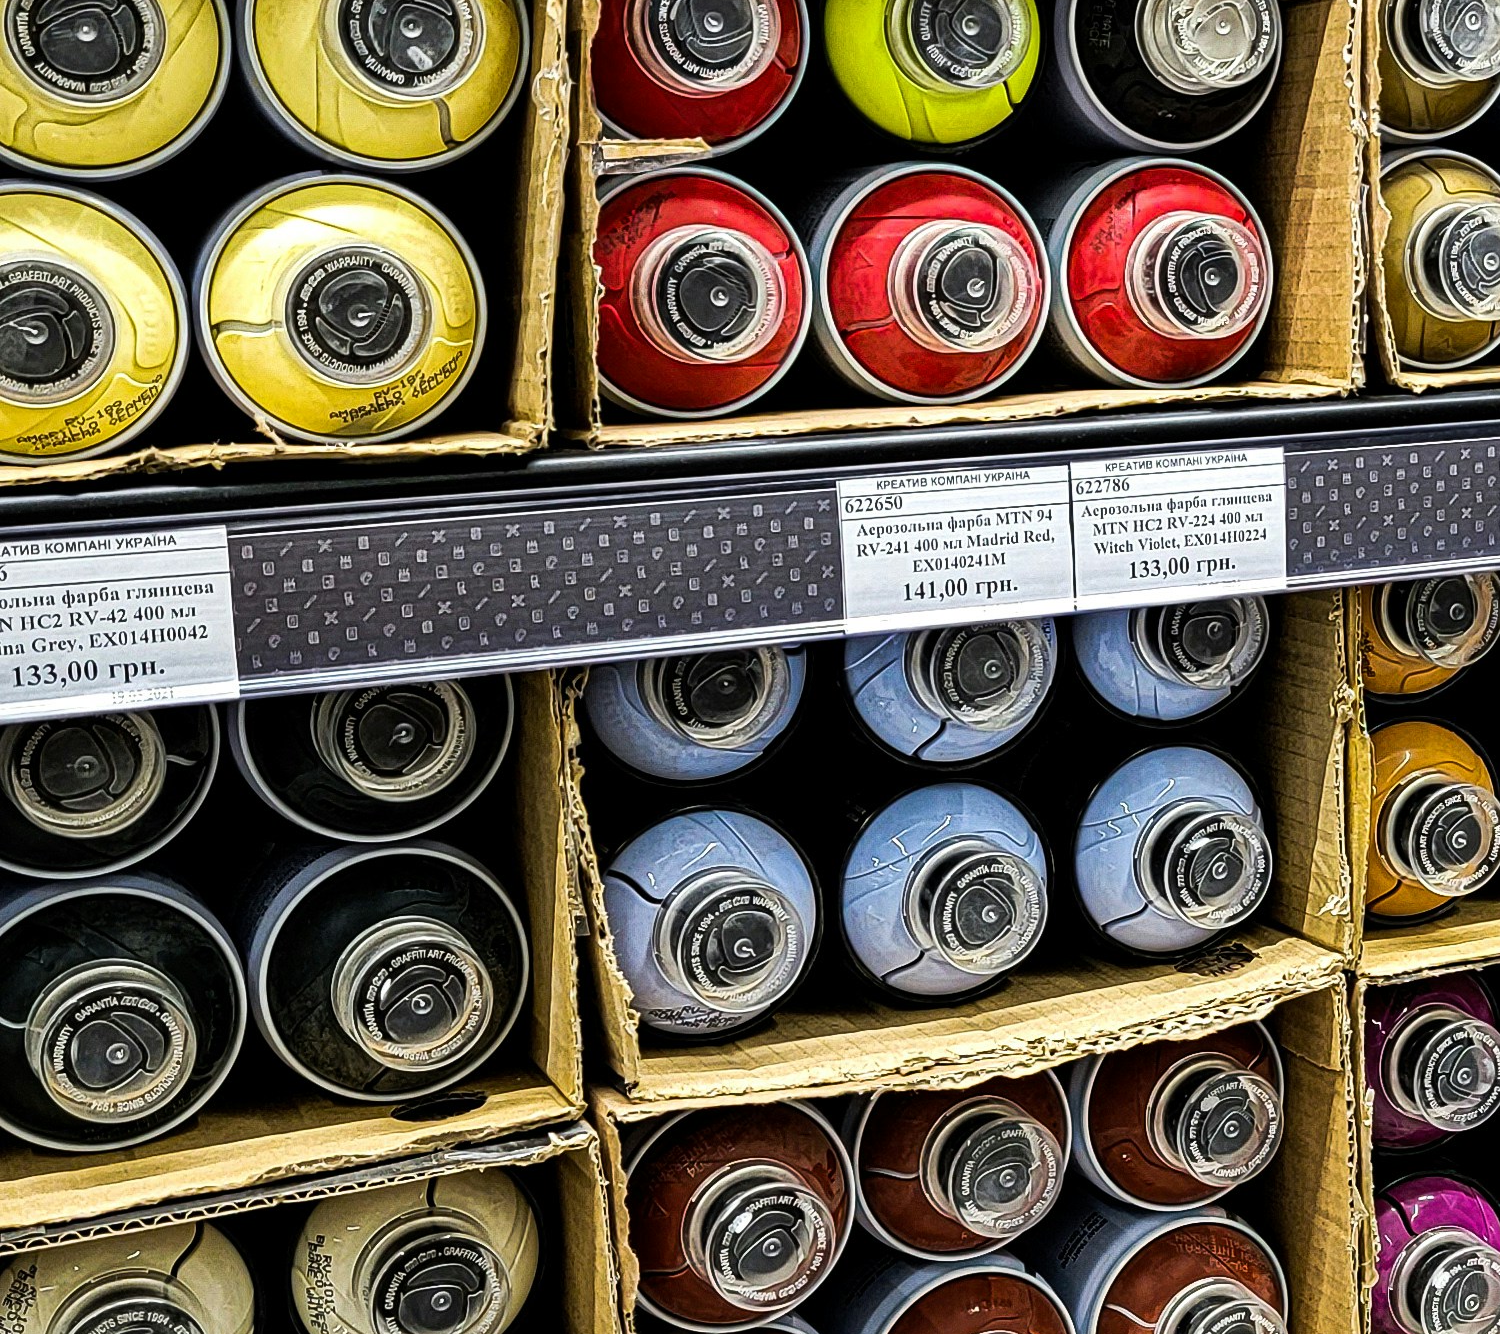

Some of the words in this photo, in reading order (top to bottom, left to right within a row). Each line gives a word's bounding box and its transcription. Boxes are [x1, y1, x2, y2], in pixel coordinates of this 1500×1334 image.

[876, 477, 928, 491] КРЕАТИВ
[930, 473, 981, 486] КОМПАНІ
[844, 495, 903, 514] 622650
[856, 521, 943, 539] Аерозольна
[947, 514, 992, 533] фарба
[1036, 508, 1053, 523] 94
[856, 540, 909, 558] RV-241
[913, 538, 939, 552] 400
[943, 539, 963, 550] мл
[966, 531, 1019, 549] Madrid
[1023, 528, 1055, 544] Red,
[913, 552, 1006, 573] EX0140241M
[904, 577, 968, 602] 141,00
[975, 579, 1018, 600] грн.
